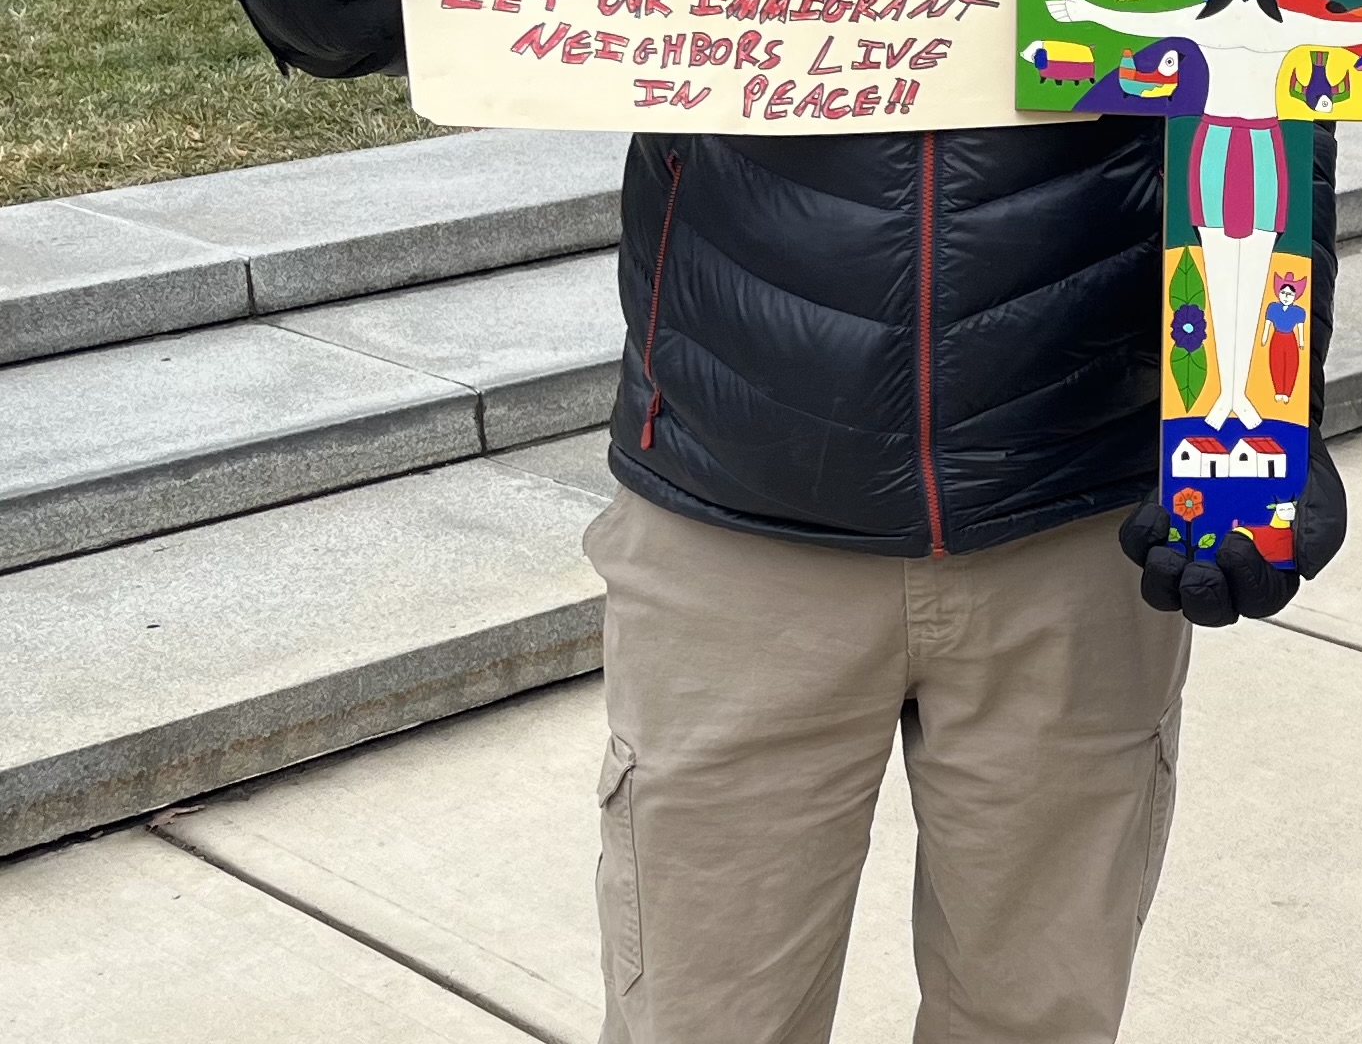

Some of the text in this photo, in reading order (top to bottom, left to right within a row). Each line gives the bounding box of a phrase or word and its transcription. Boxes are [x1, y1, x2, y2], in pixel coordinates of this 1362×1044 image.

[511, 22, 952, 75] NEIGHBORS LIVE
[634, 77, 920, 120] IN PEACE!!
